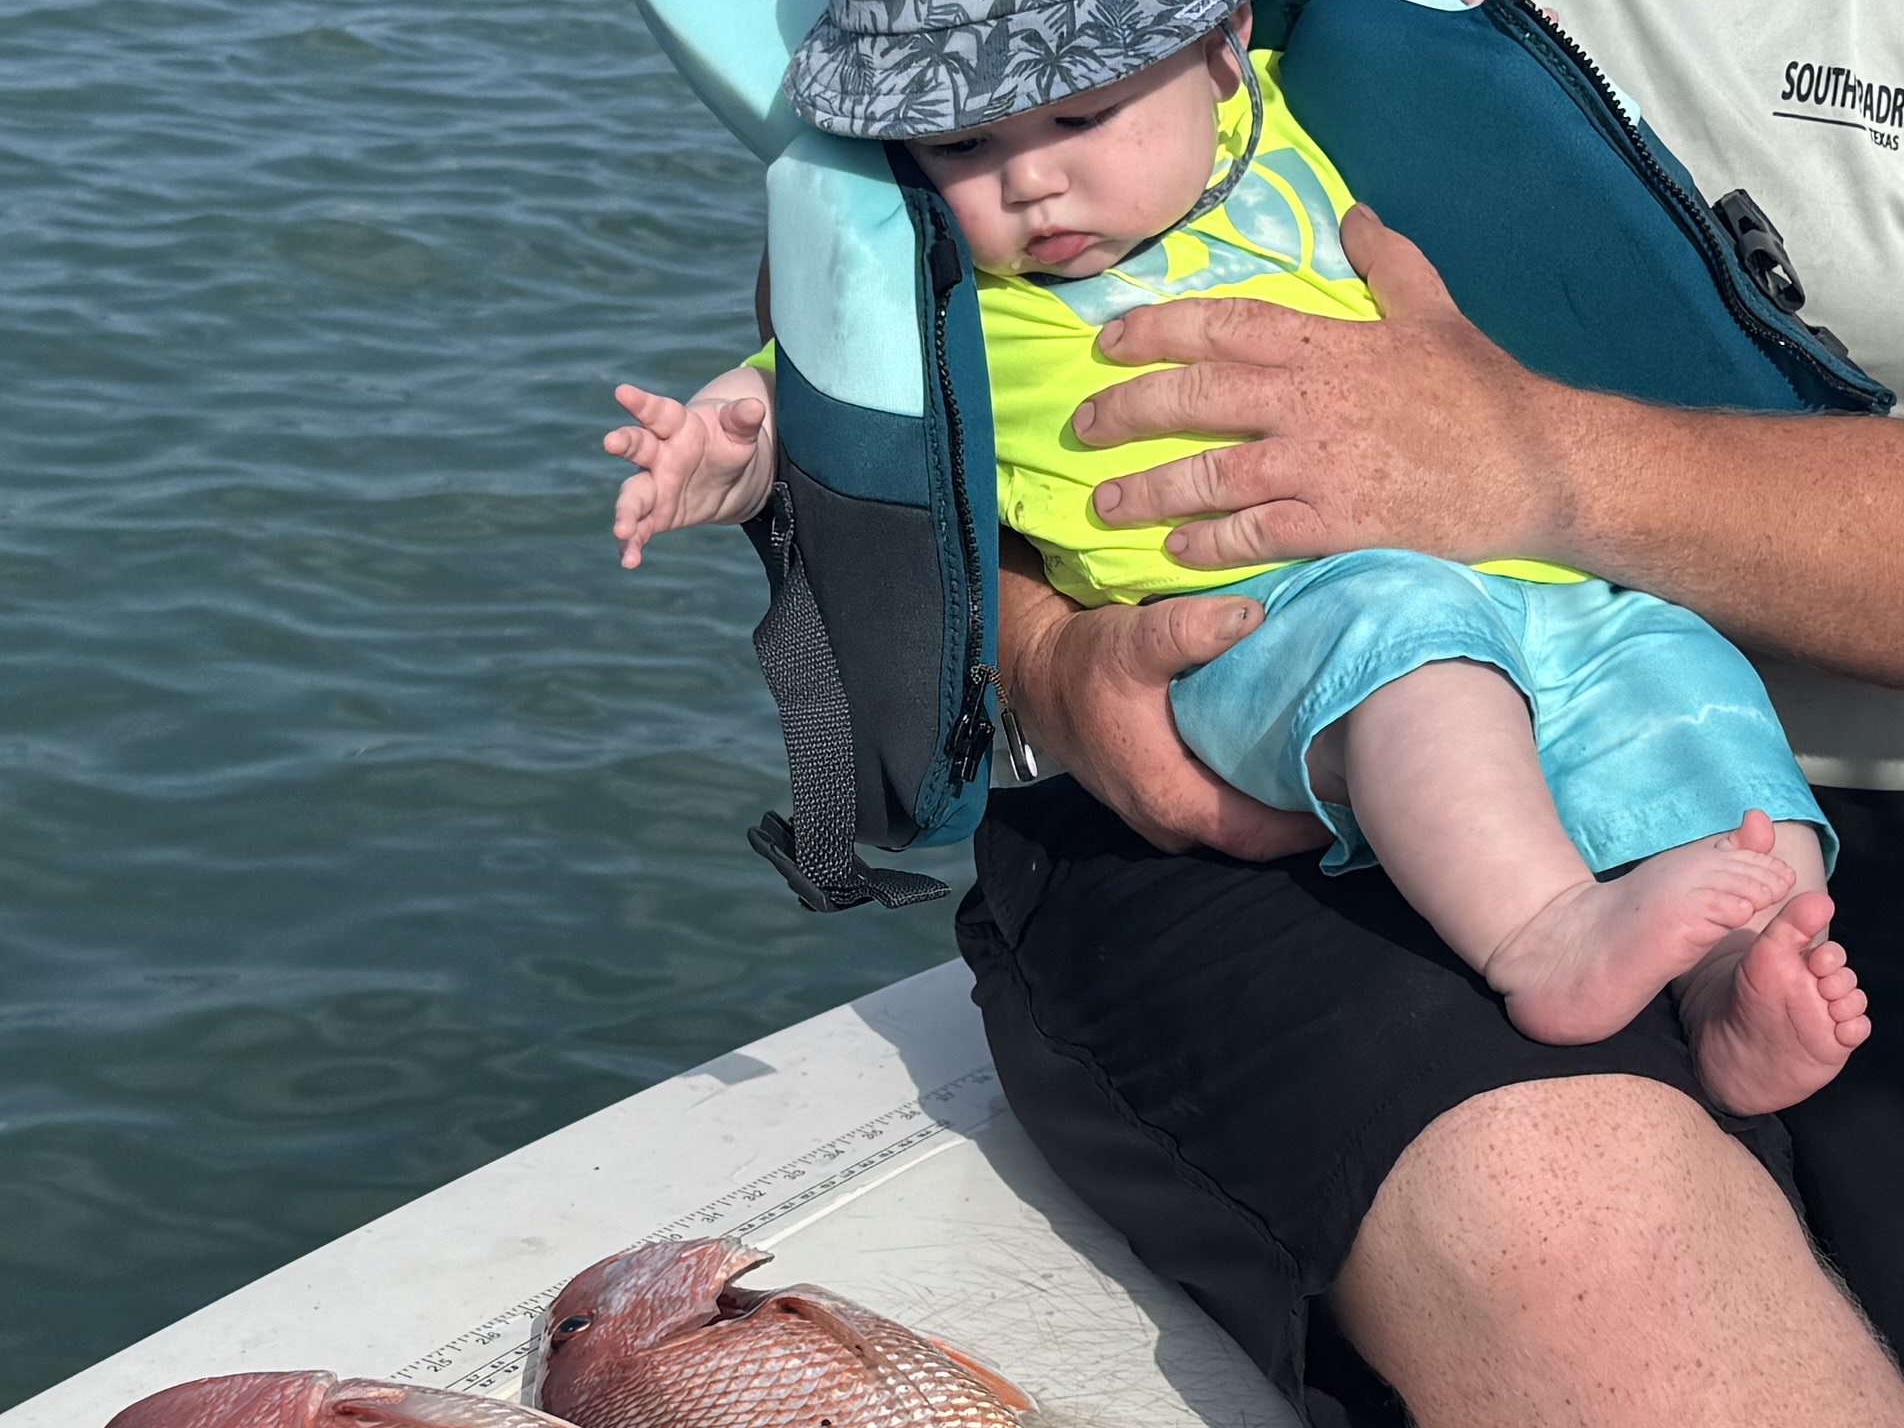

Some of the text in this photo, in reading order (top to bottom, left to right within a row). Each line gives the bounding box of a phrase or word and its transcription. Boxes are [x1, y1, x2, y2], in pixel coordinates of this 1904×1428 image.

[1781, 61, 1856, 109] SOUTH
[1868, 127, 1899, 151] TEXAS
[427, 1305, 546, 1373] 25 26 27
